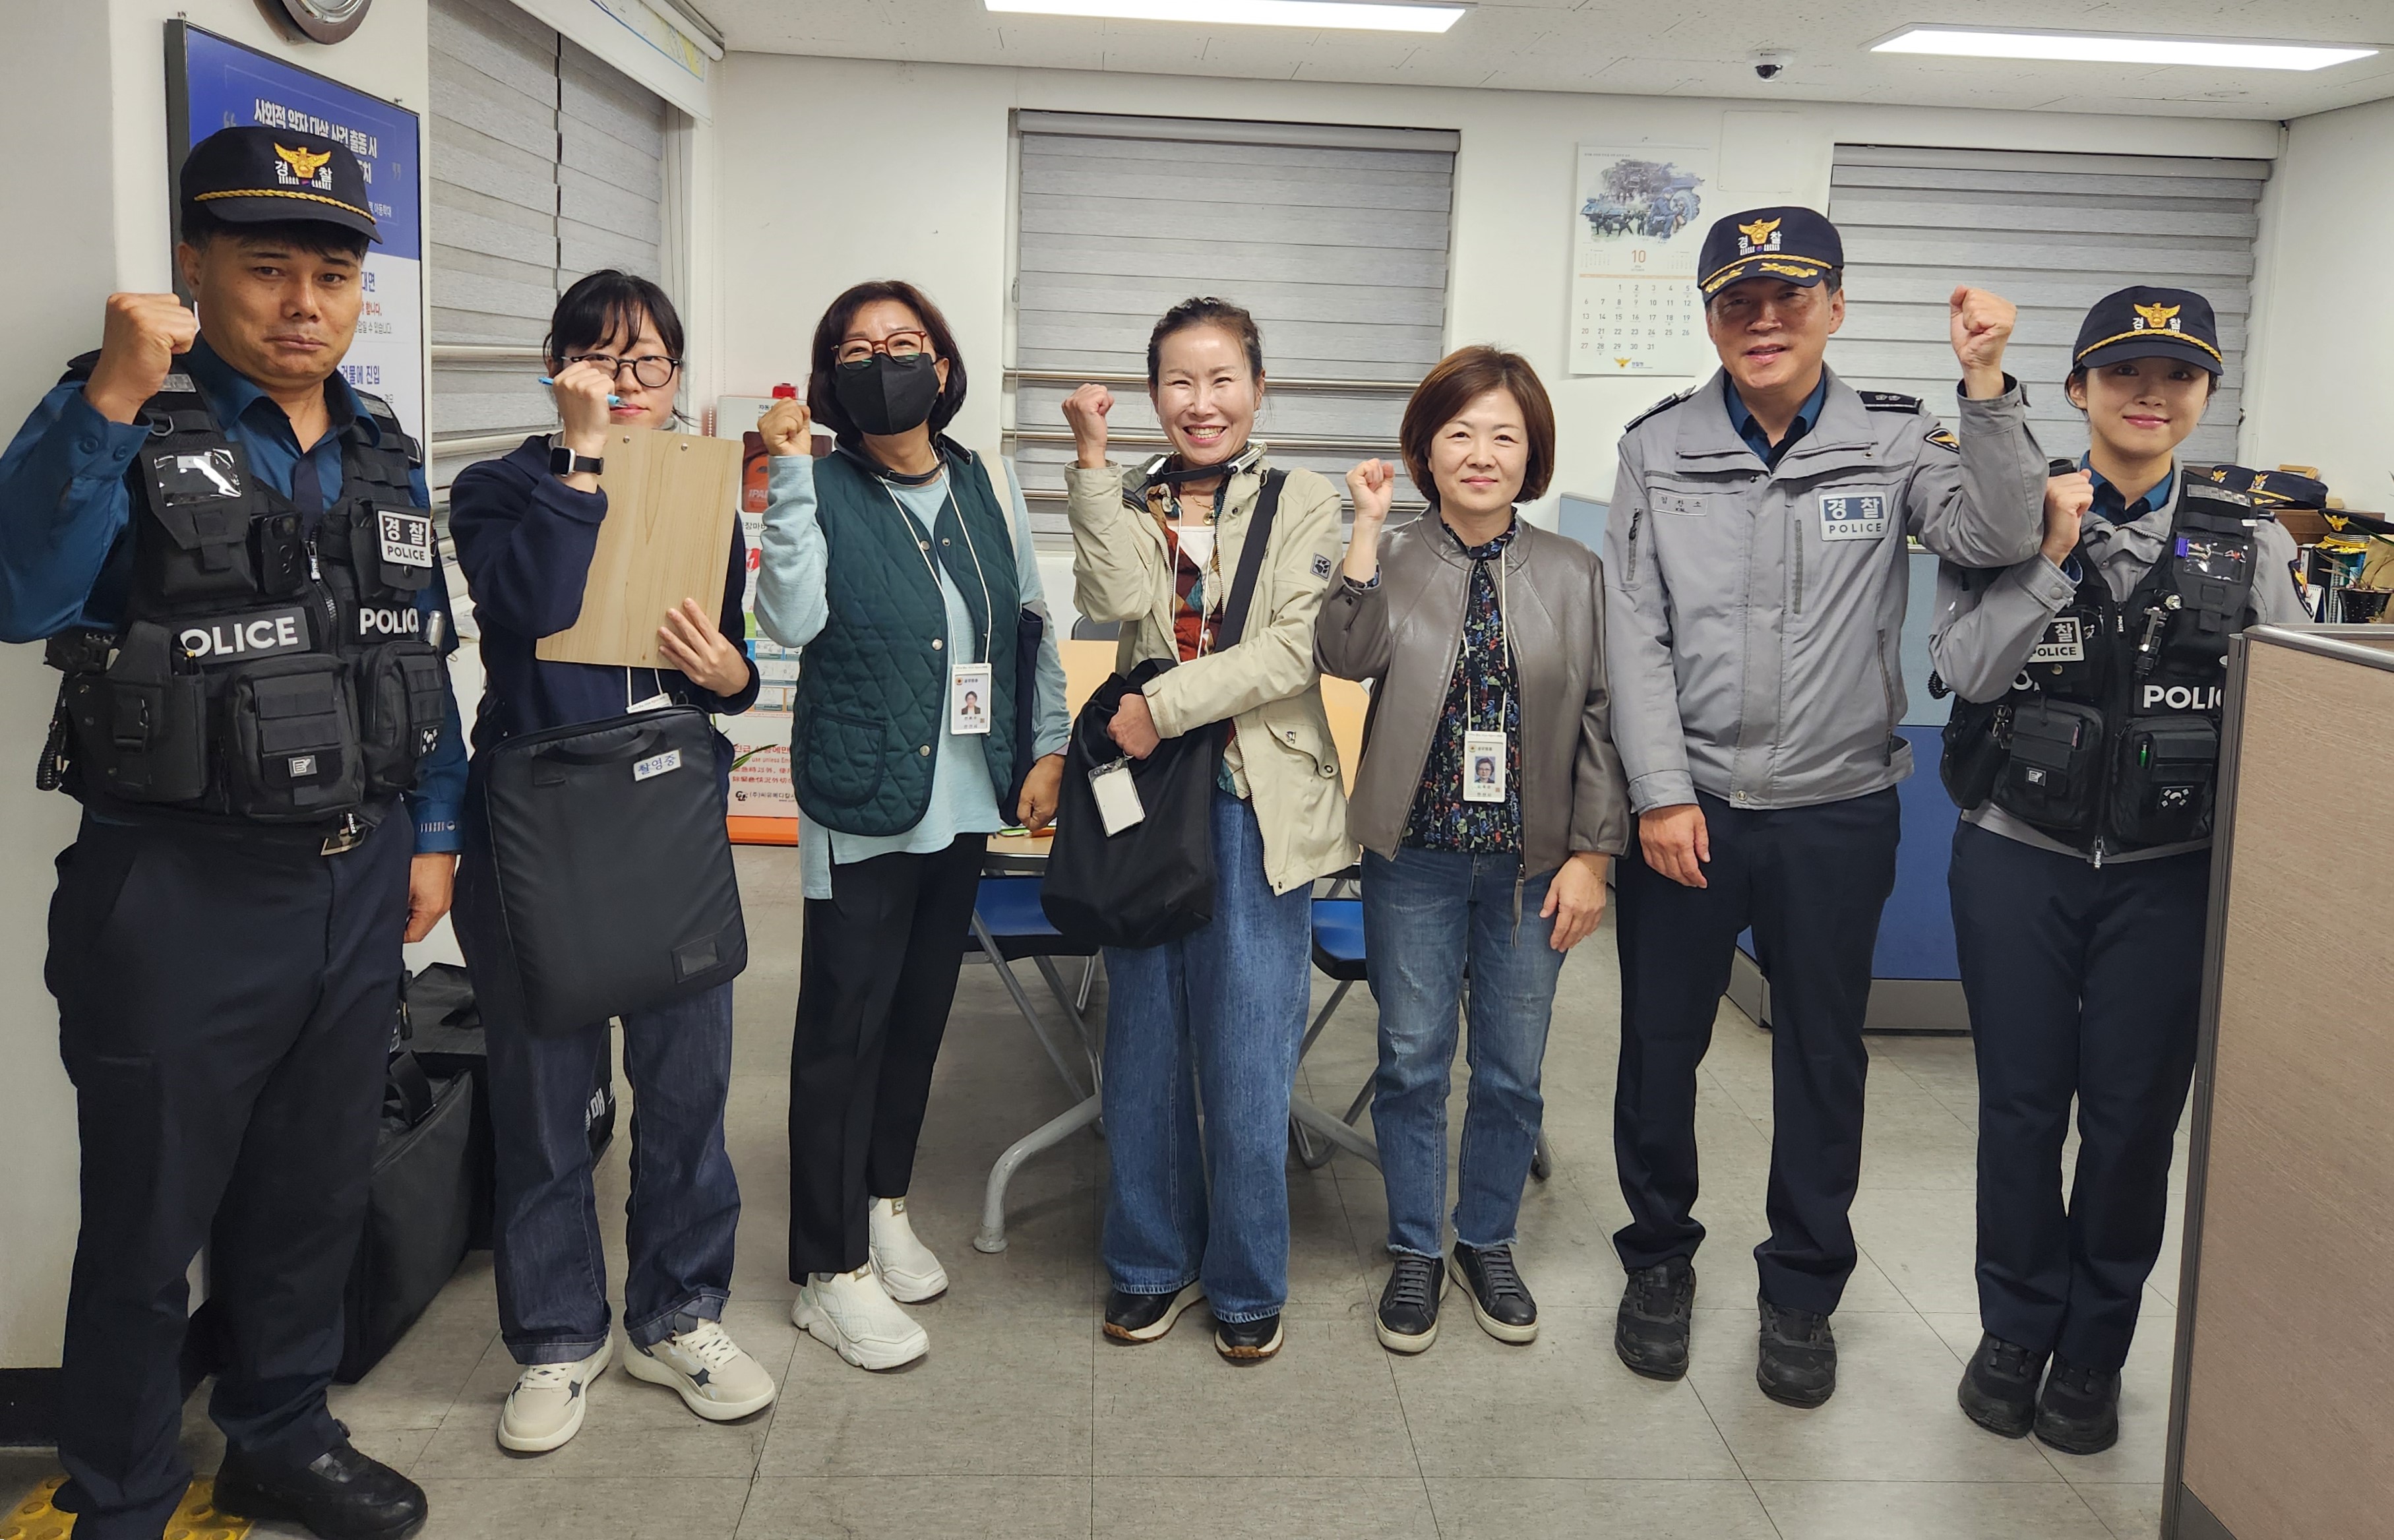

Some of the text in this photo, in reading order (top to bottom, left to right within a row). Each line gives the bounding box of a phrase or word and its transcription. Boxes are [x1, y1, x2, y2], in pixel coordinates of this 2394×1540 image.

[254, 98, 286, 129] 사회적
[350, 129, 367, 154] 출동
[368, 137, 377, 158] 시
[1632, 250, 1646, 263] 10
[366, 365, 381, 385] 진입
[1829, 522, 1882, 534] POLICE
[387, 545, 425, 561] POLICE
[180, 616, 299, 658] OLICE
[2143, 684, 2222, 710] POLI
